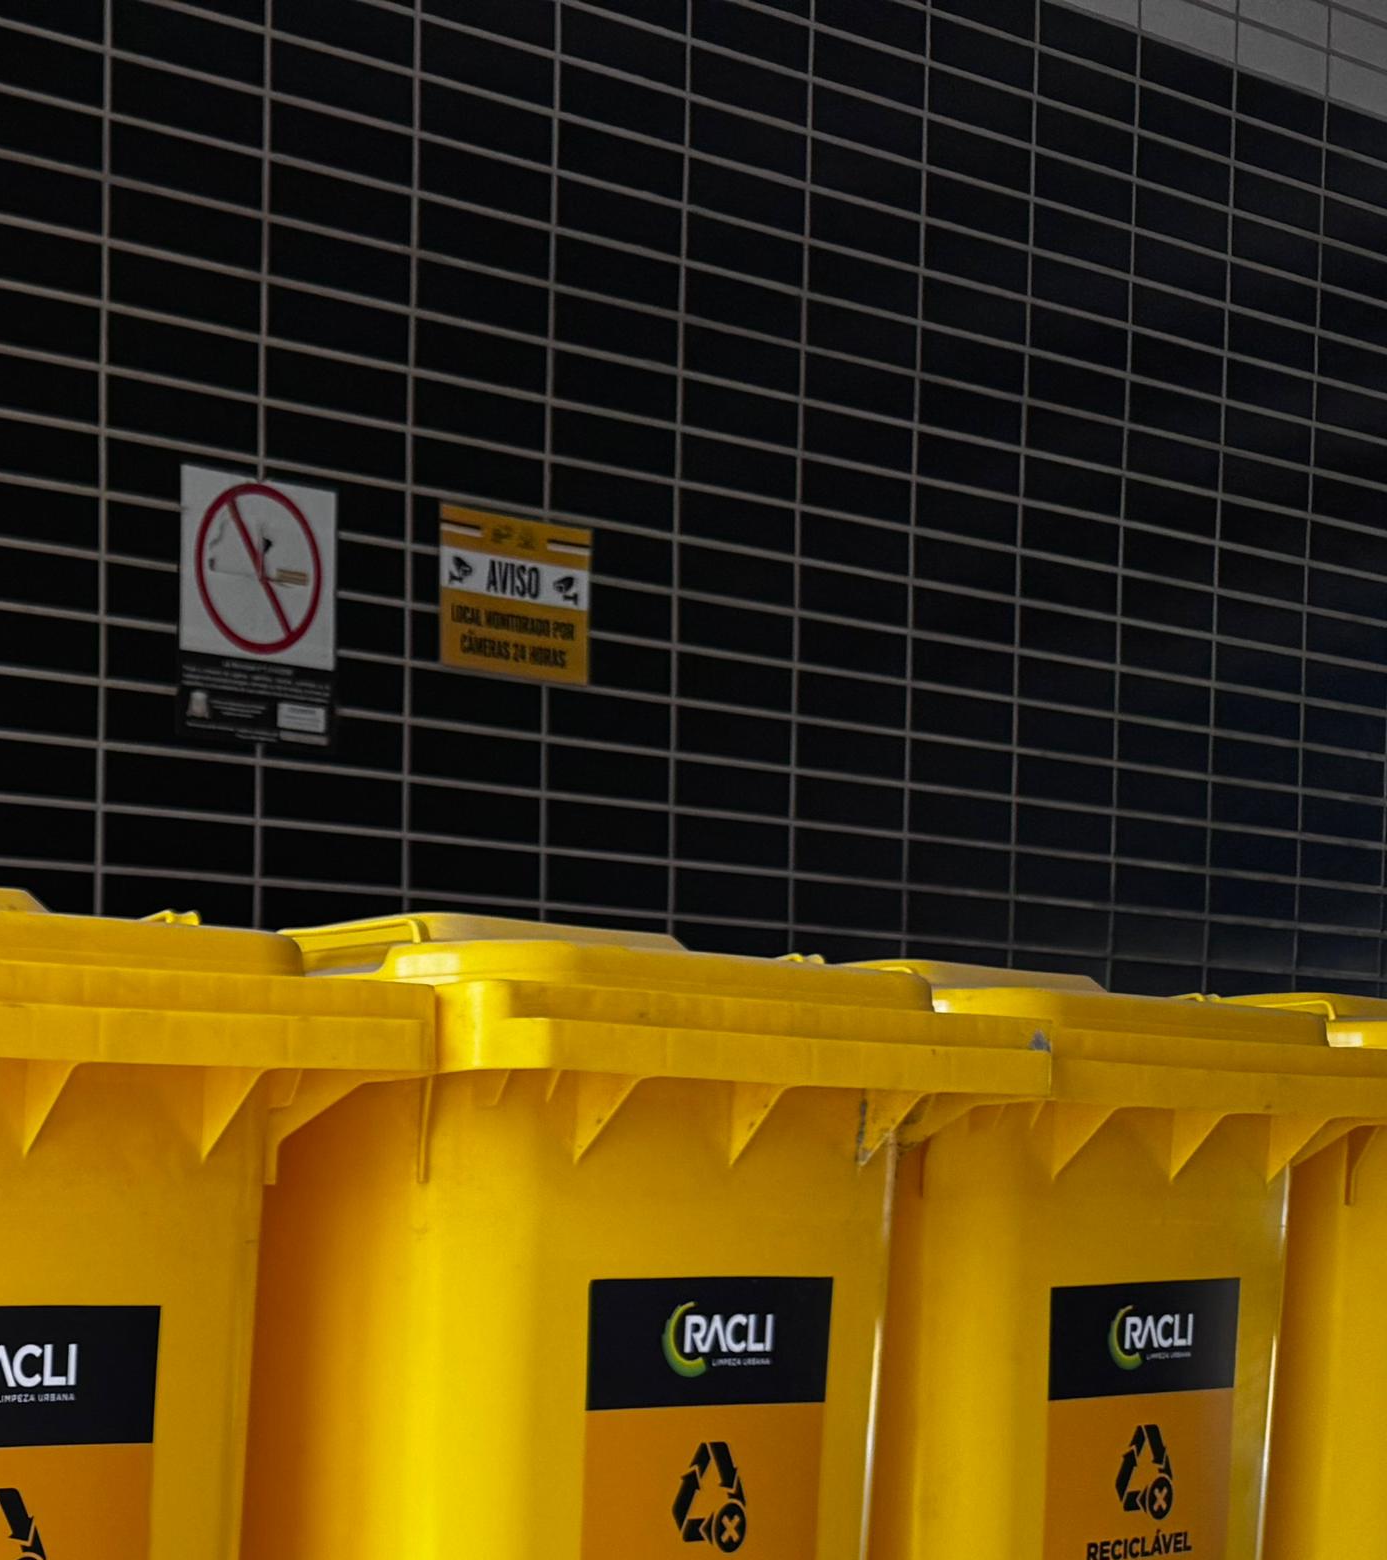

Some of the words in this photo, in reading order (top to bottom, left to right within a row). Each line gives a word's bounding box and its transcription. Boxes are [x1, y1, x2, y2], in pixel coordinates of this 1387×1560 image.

[486, 559, 541, 599] AVISO
[451, 603, 482, 627] LOCAL
[552, 621, 574, 641] POR
[684, 1314, 775, 1353] RACLI
[1125, 1313, 1194, 1350] RACLI
[38, 1393, 75, 1401] URBANA
